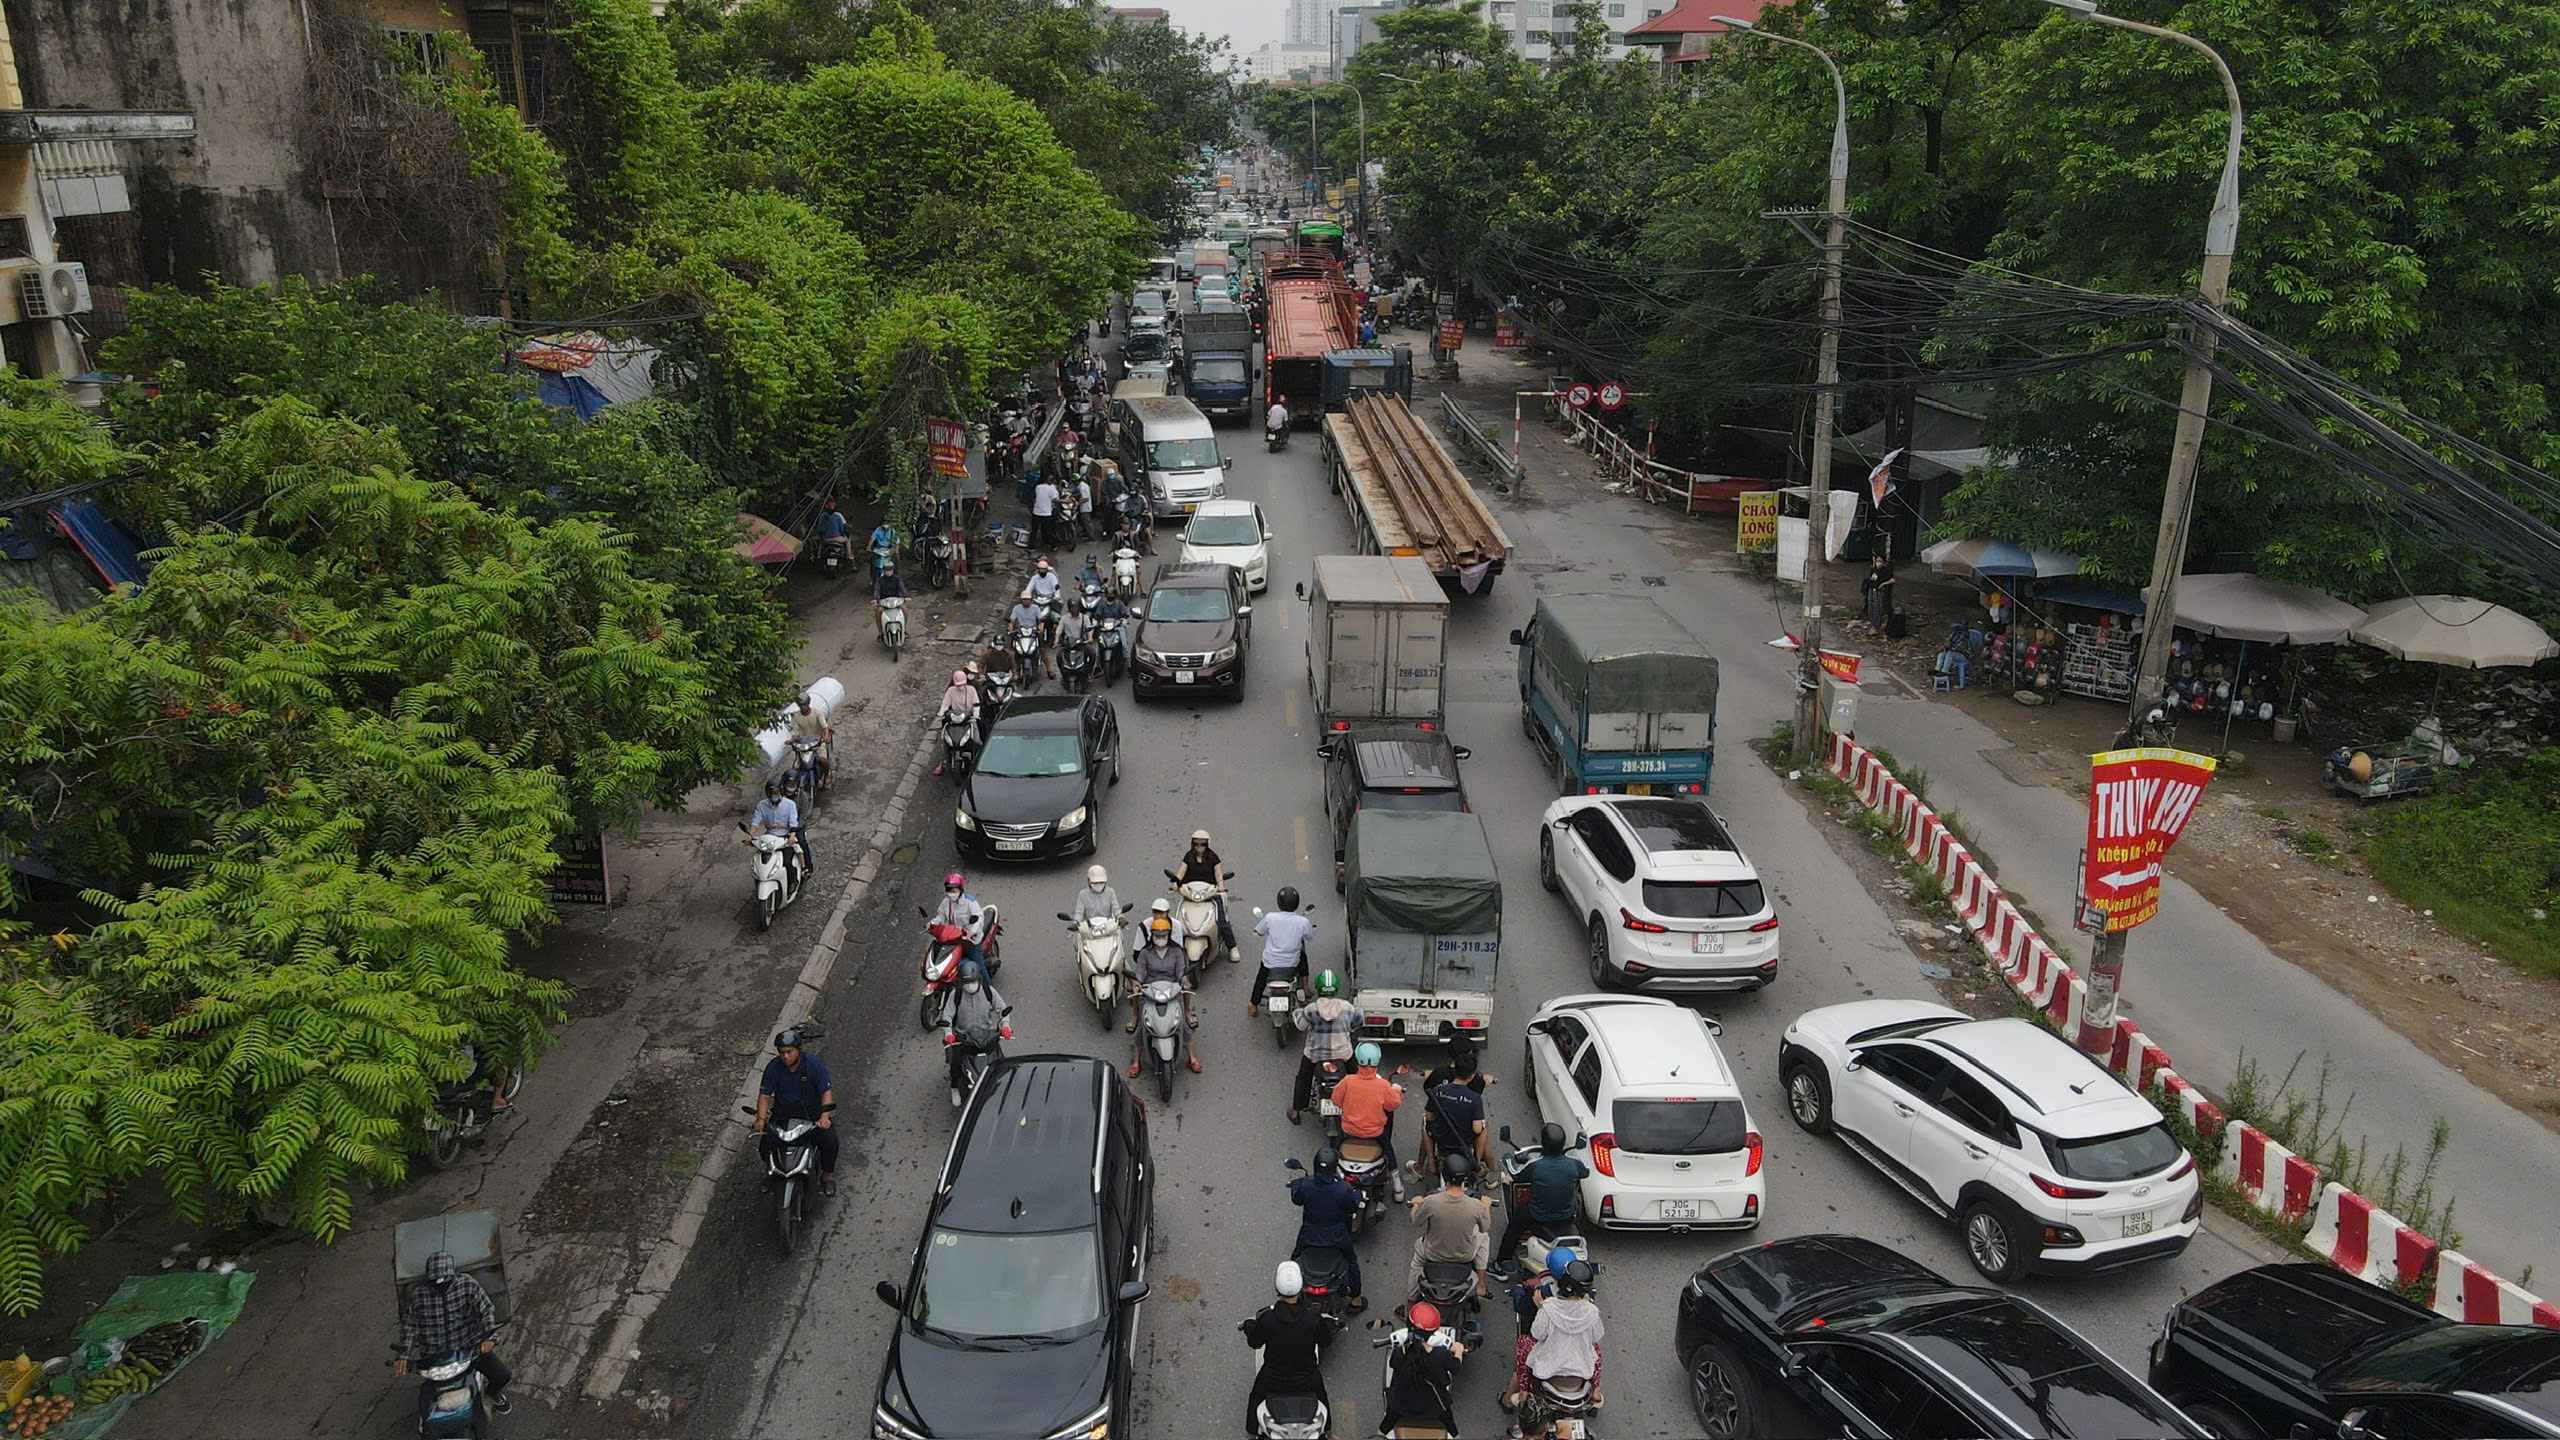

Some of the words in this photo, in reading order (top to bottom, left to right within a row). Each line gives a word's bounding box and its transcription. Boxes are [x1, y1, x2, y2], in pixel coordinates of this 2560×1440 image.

[1742, 502, 1777, 517] CHÁO
[1741, 518, 1775, 535] LÒNG
[1622, 760, 1666, 773] 29H-375.34
[1704, 934, 1718, 943] 30G
[1438, 941, 1497, 953] 29H-318.32
[1390, 998, 1458, 1010] SUZUKI
[1672, 1200, 1689, 1209] 30G
[2130, 1212, 2146, 1224] 99A
